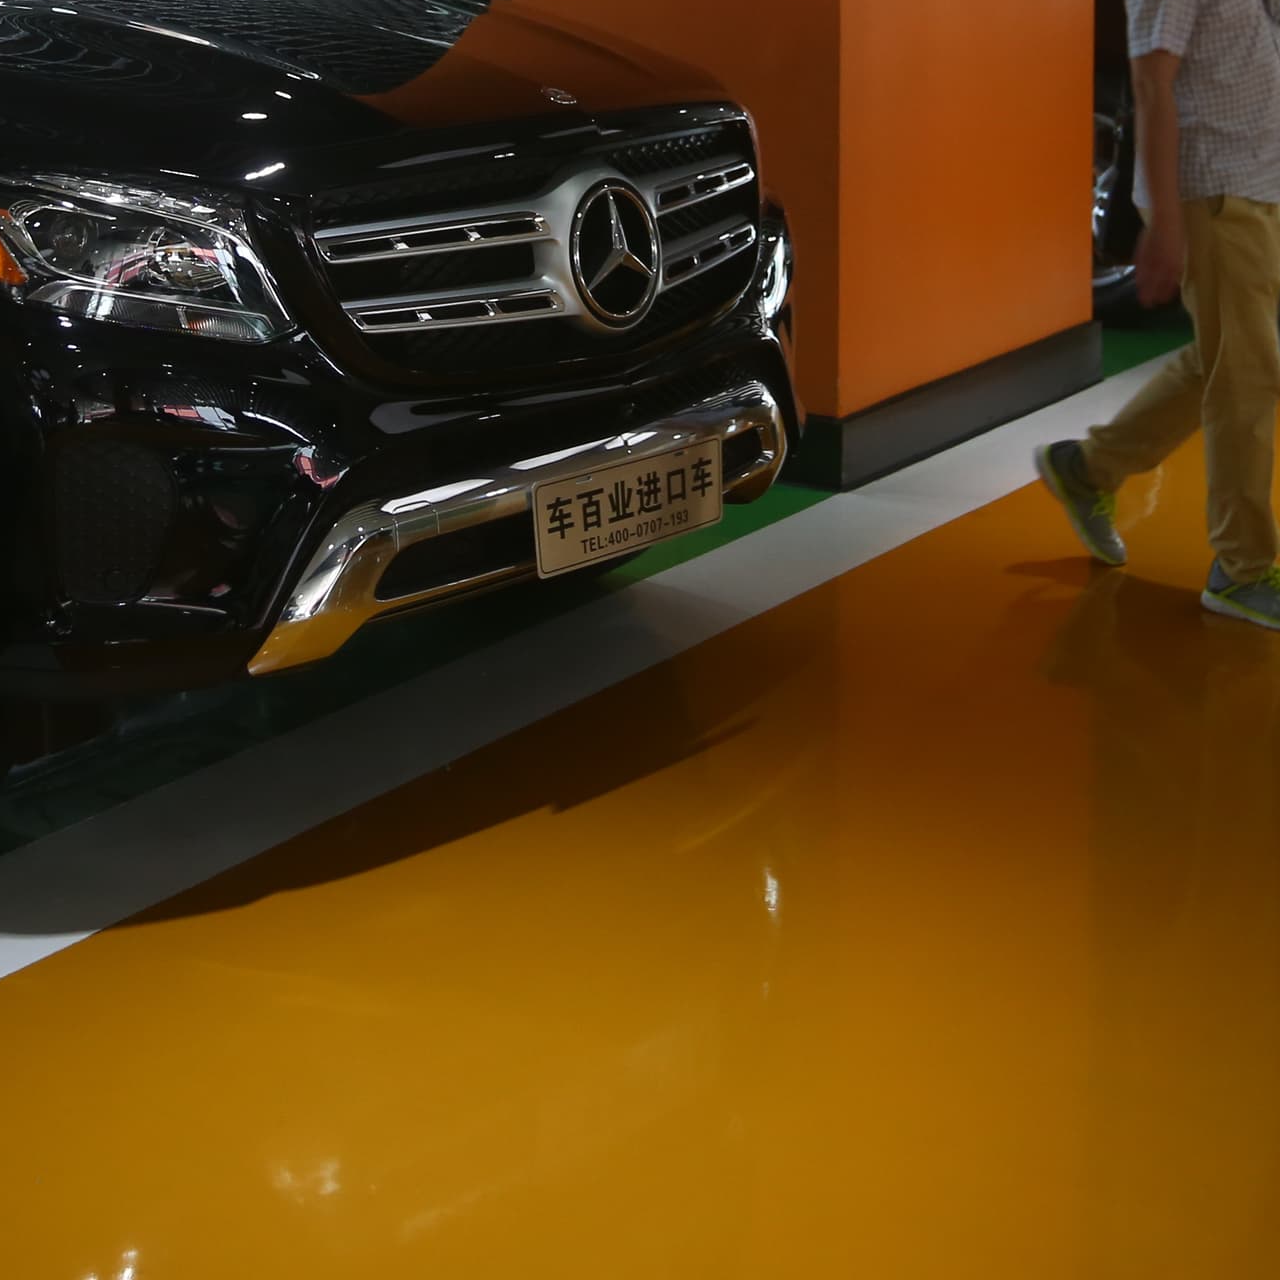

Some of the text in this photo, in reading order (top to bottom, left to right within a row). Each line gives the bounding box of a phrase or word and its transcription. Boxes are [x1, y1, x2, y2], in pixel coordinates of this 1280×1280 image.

[546, 457, 713, 540] 车百业进口车
[581, 509, 689, 555] TEL:400-0707-193
